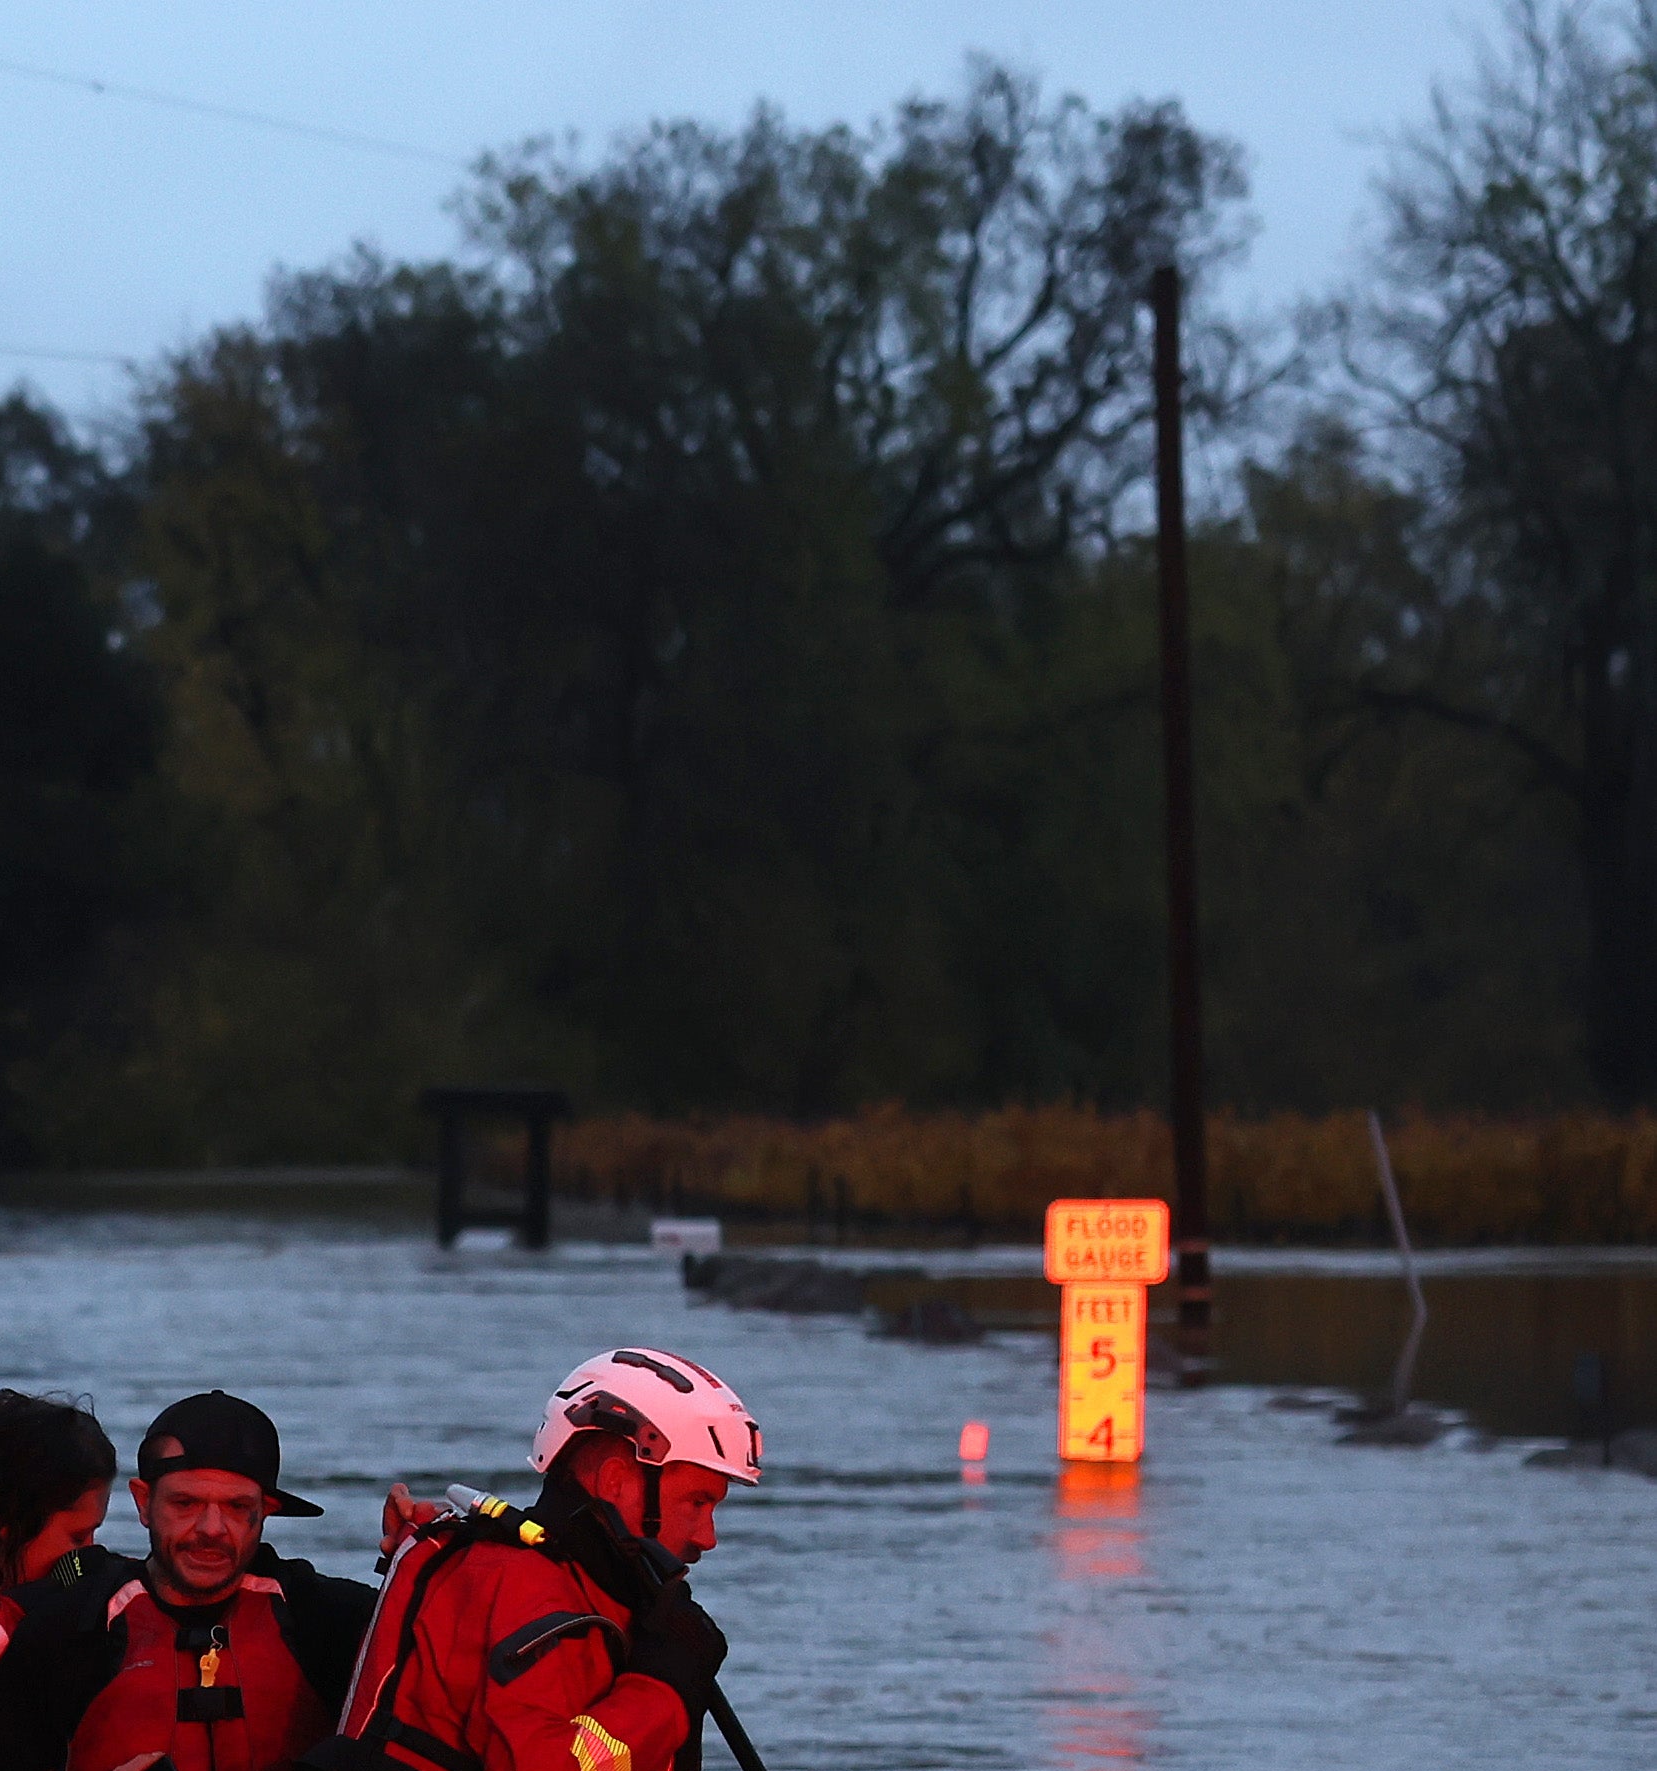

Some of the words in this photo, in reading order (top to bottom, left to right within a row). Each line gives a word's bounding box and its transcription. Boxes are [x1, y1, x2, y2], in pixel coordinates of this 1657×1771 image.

[1066, 1215, 1148, 1240] FLOOD
[1065, 1245, 1148, 1271] GAUGE
[1076, 1299, 1133, 1323] FEET
[1091, 1338, 1116, 1379] 5
[1088, 1416, 1113, 1458] 4
